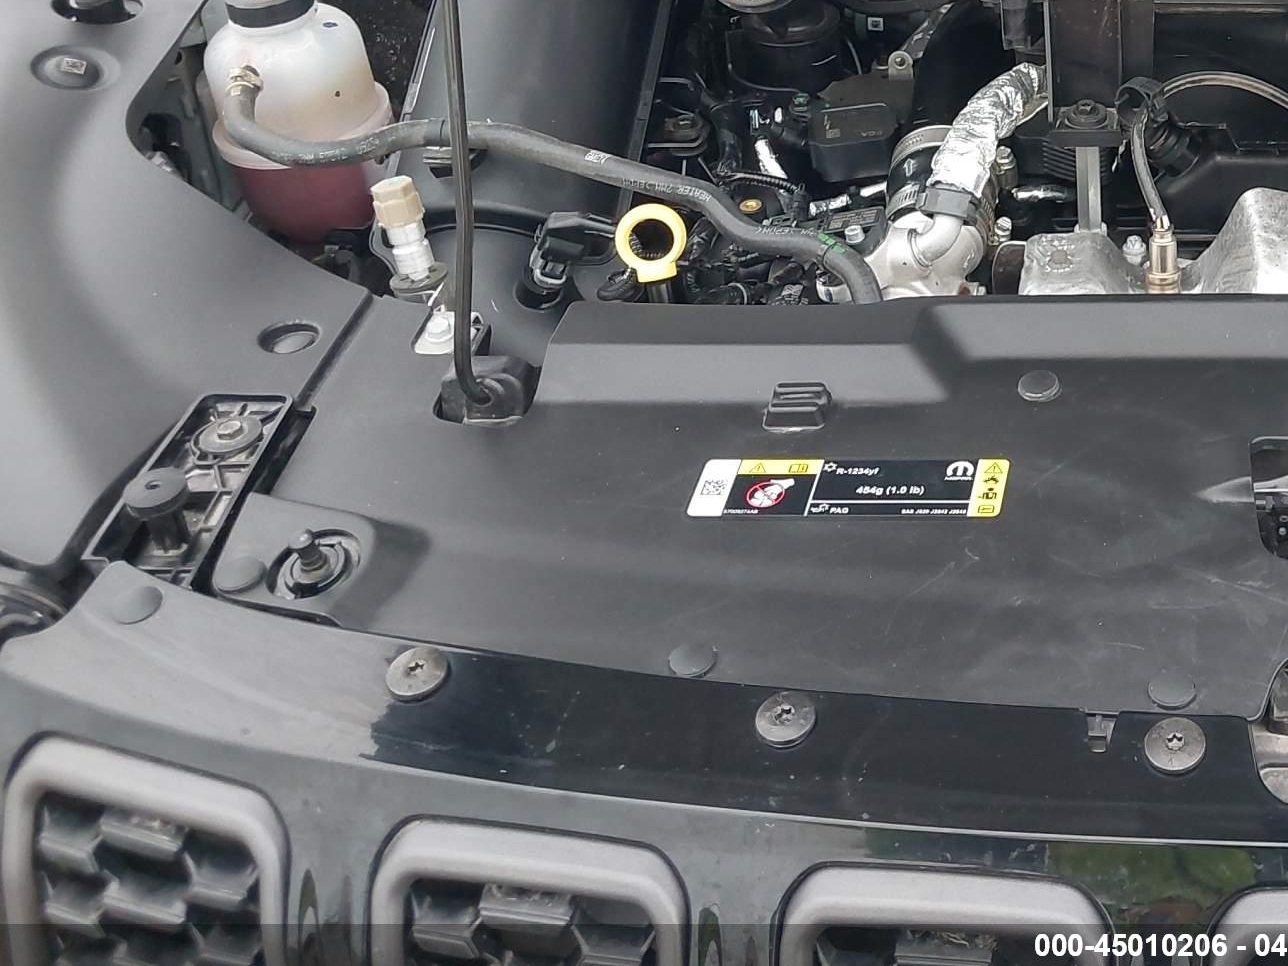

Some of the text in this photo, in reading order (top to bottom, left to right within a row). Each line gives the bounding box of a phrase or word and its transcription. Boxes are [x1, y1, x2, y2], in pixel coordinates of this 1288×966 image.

[676, 185, 712, 202] HEATER
[835, 466, 880, 476] R-1234yf
[855, 485, 925, 497] 454g (1.0 lb)
